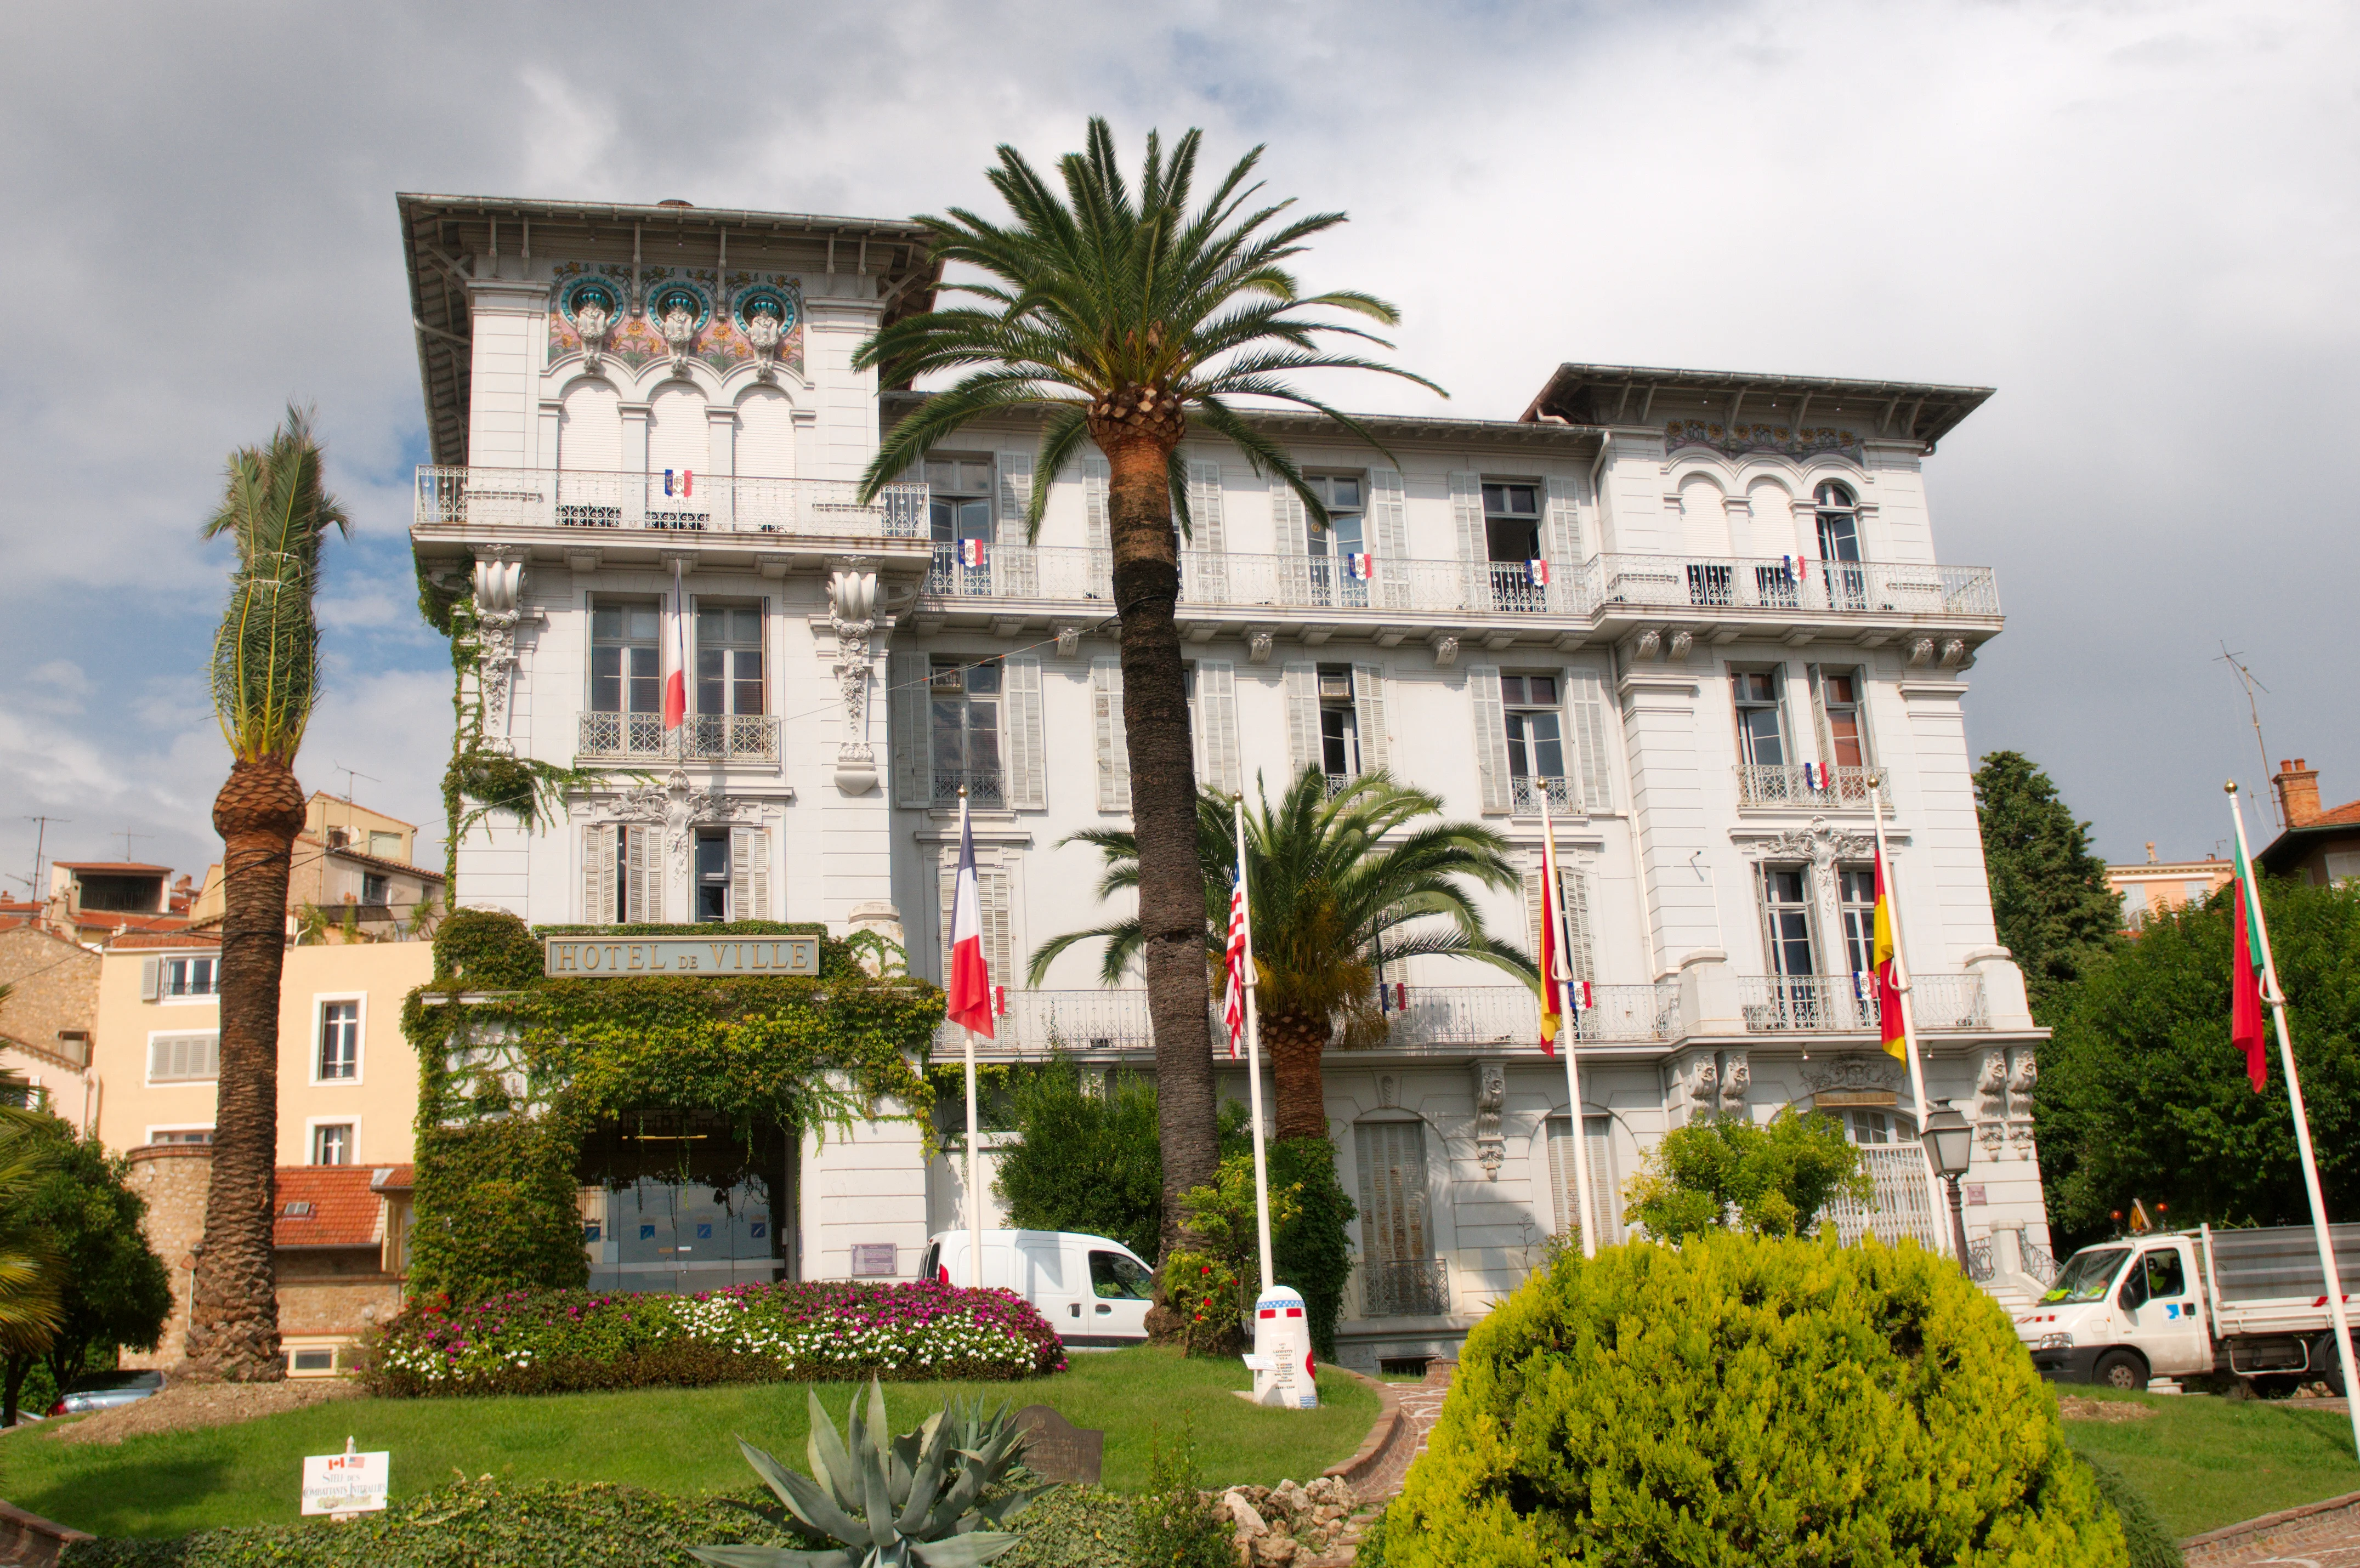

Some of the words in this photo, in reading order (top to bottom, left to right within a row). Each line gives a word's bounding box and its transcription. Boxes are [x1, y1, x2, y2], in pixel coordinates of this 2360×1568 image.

[558, 944, 667, 970] HOTEL
[678, 956, 699, 969] DE
[710, 943, 808, 969] VILLE
[1818, 1094, 1850, 1103] SALLE
[1856, 1093, 1895, 1103] BELLINI
[303, 1486, 348, 1498] COMBATTANTS
